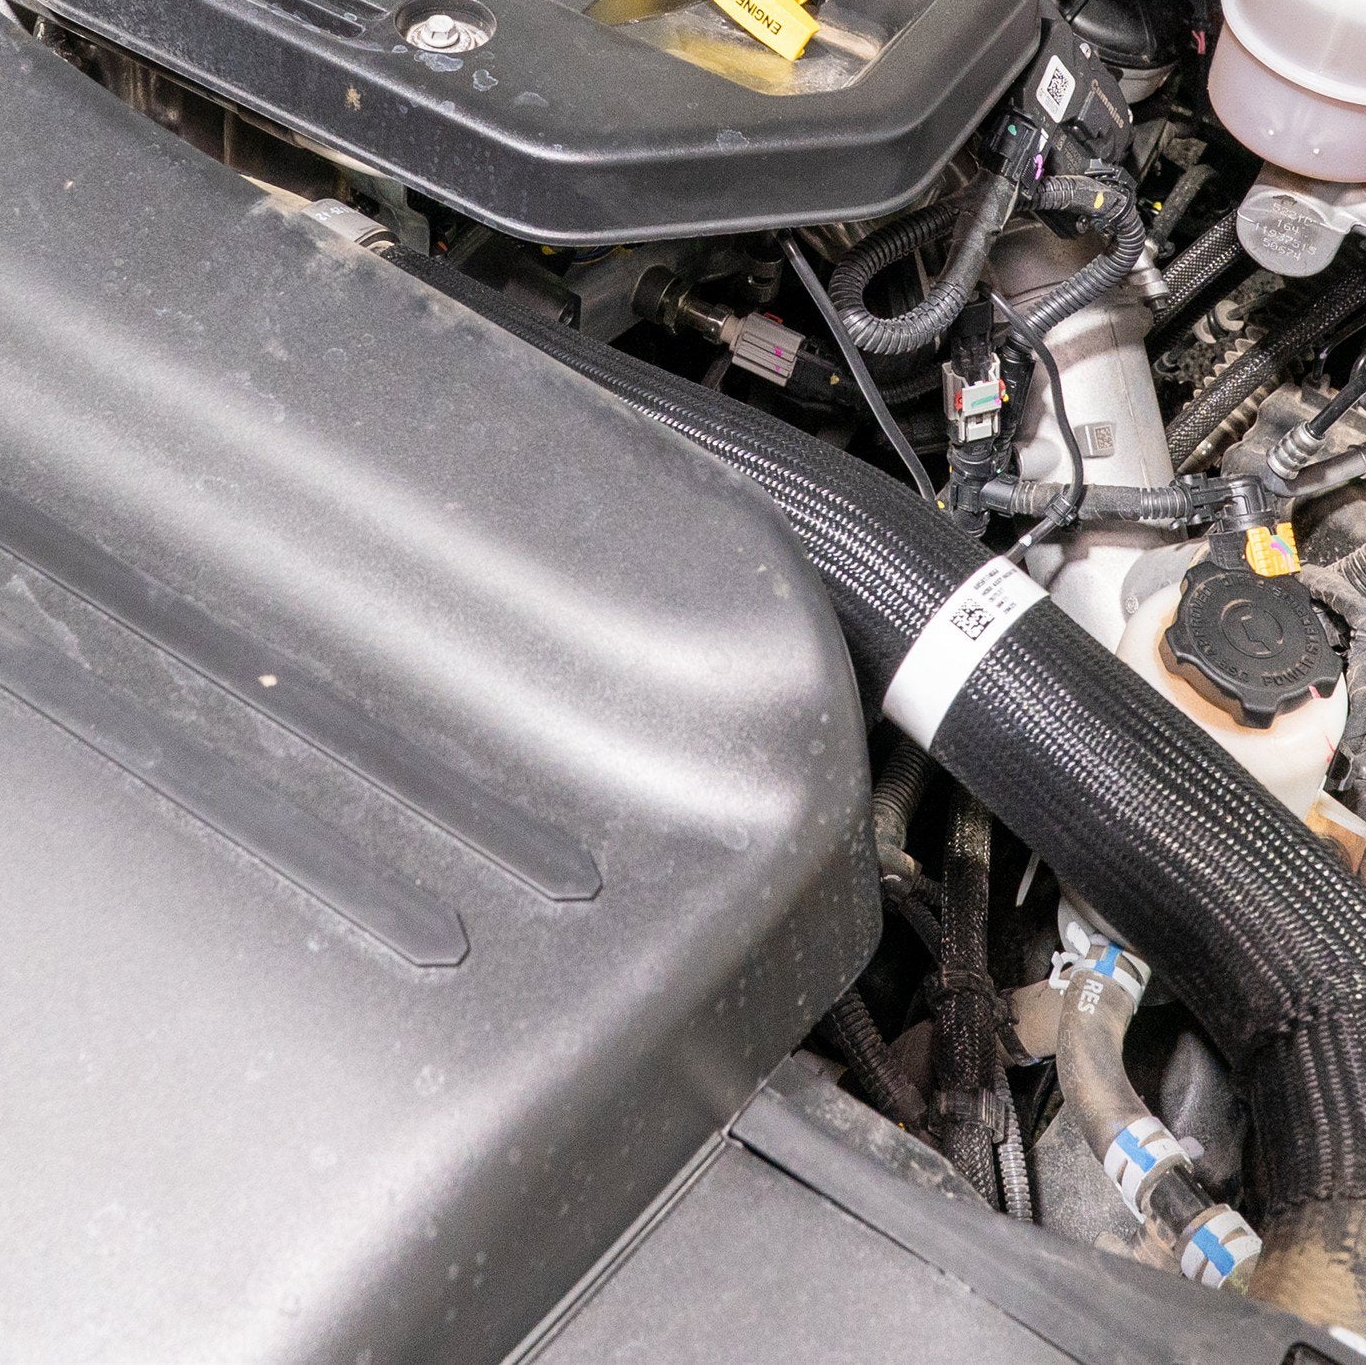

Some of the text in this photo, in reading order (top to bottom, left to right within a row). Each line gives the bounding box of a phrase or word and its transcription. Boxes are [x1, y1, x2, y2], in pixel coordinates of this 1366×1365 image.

[1091, 78, 1125, 129] Cummins
[1260, 656, 1315, 687] POWER
[1077, 977, 1105, 1016] RES
